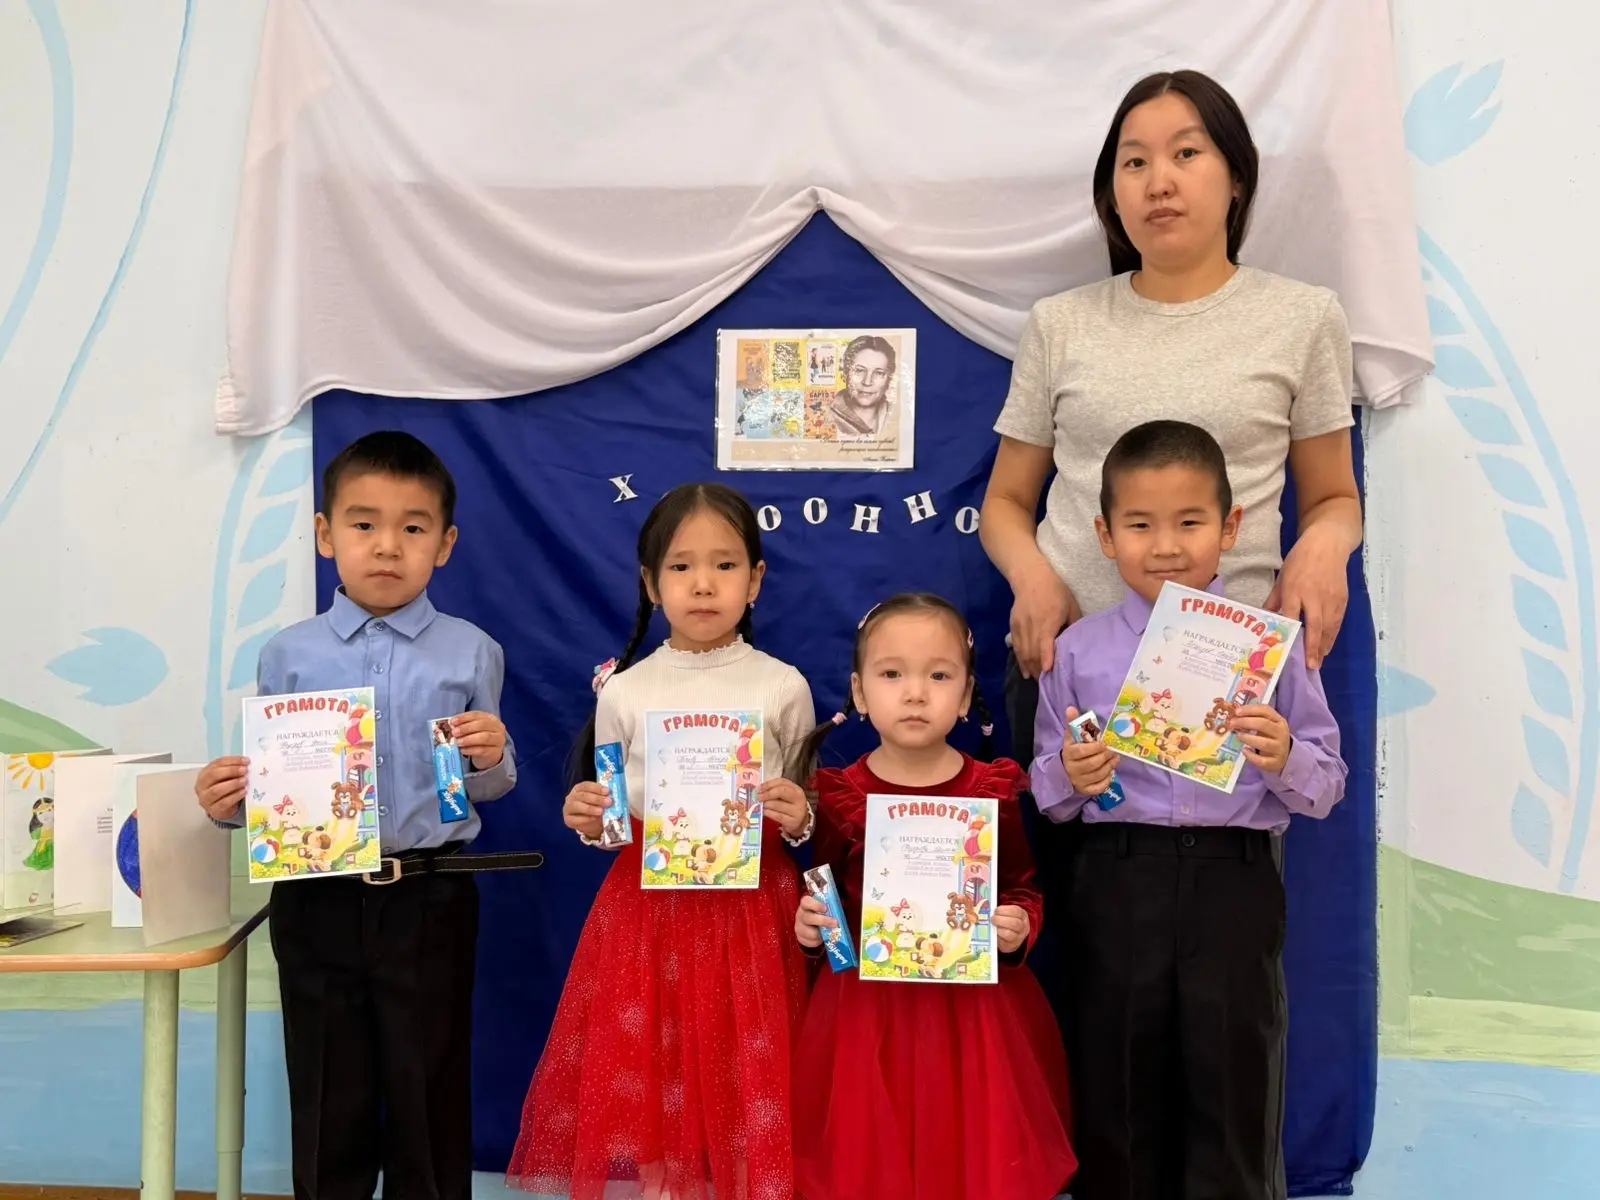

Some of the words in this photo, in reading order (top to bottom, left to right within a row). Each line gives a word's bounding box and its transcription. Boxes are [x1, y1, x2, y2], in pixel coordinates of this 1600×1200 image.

[1181, 598, 1266, 636] ГРАМОТА
[264, 697, 350, 719] ГРАМОТА
[663, 713, 740, 732] ГРАМОТА
[888, 801, 969, 823] ГРАМОТА
[826, 941, 848, 965] babyfox
